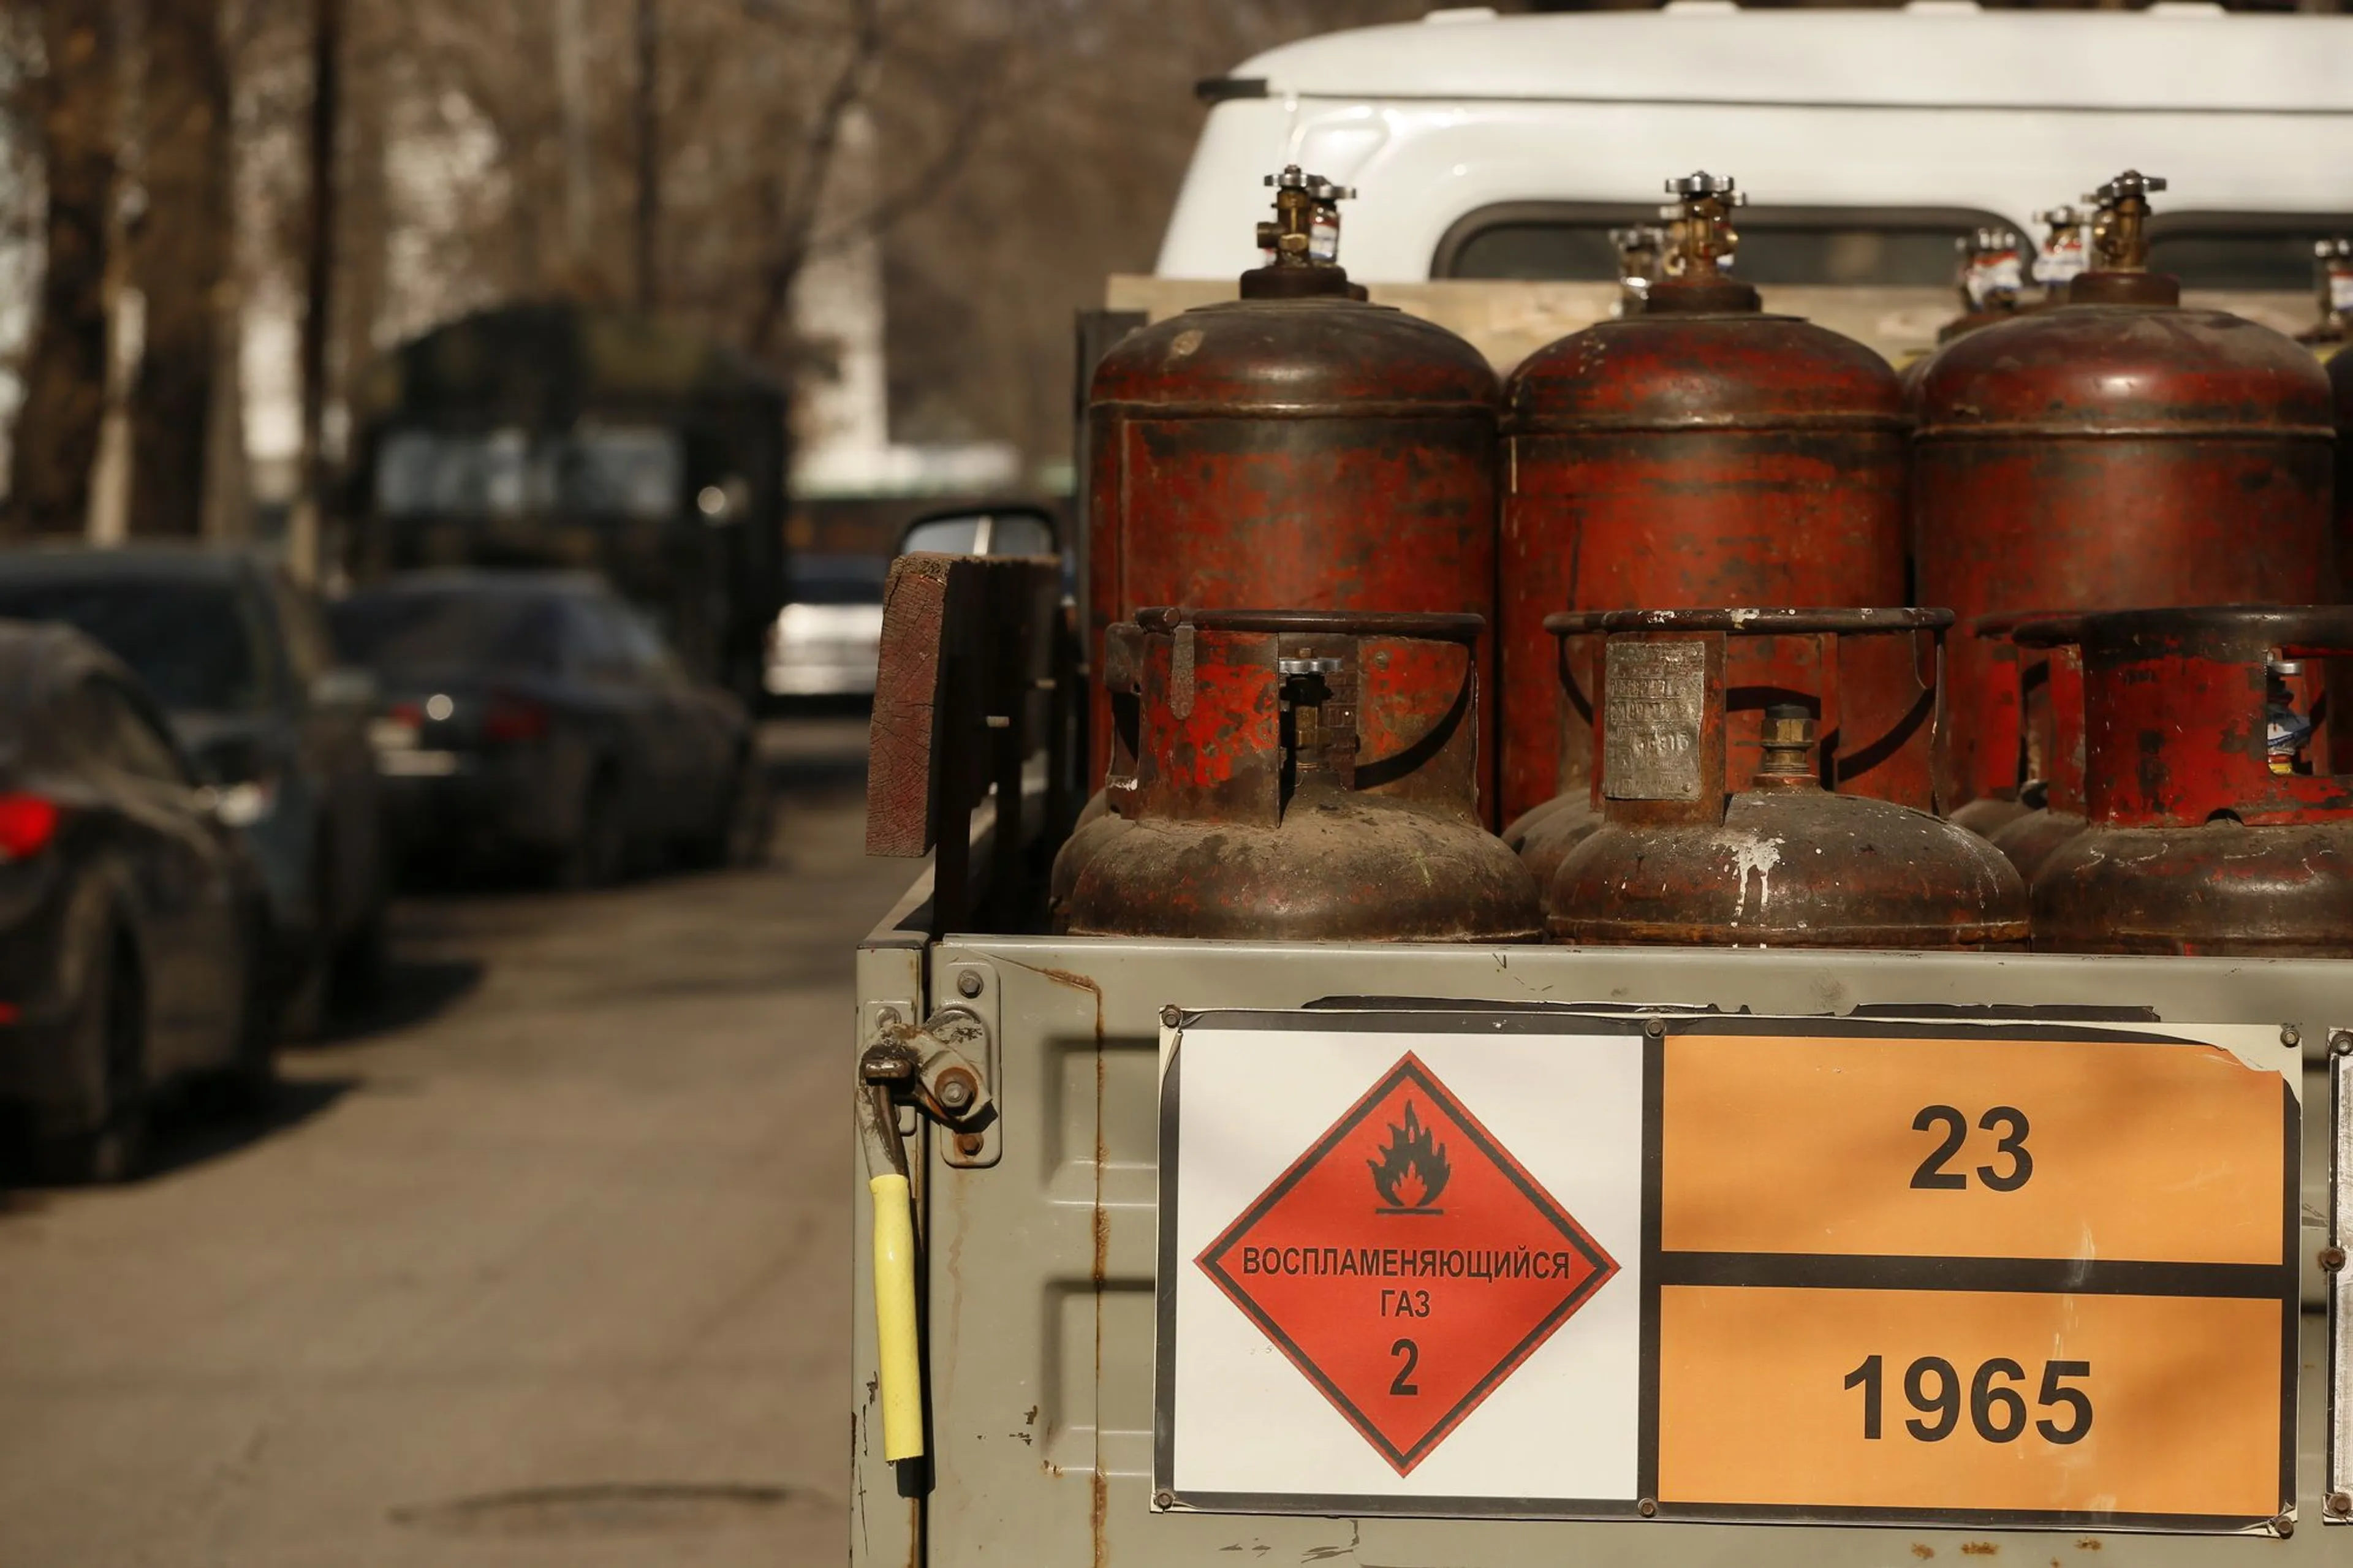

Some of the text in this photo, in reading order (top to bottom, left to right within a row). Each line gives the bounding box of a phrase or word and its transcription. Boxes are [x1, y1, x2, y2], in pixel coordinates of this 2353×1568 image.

[1910, 1105, 2033, 1192] 23
[1243, 1246, 1569, 1283] ВОСПЛАМЕНЯЮЩИЙСЯ
[1381, 1290, 1430, 1317] ГАЗ
[1389, 1339, 1419, 1396] 2
[1844, 1355, 2093, 1445] 1965
